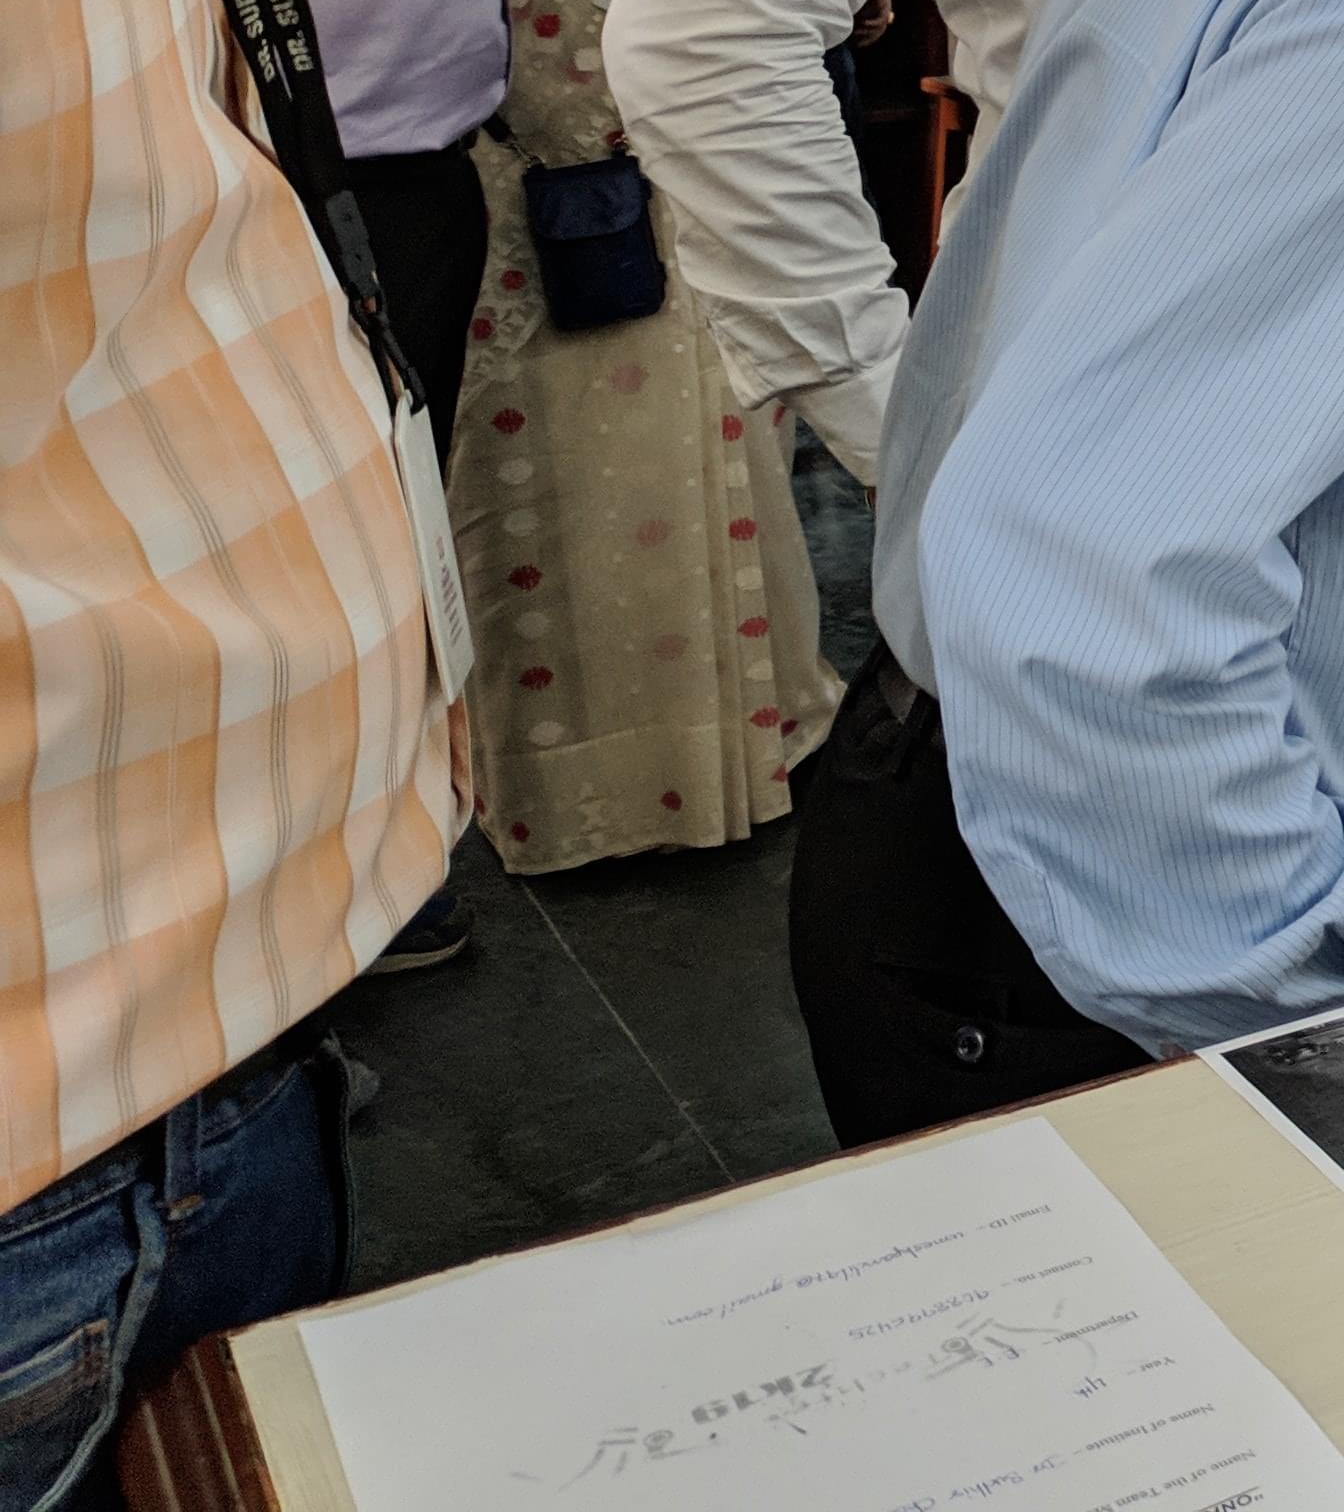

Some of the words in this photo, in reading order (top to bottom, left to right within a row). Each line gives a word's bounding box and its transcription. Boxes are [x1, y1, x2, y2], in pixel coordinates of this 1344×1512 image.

[257, 38, 275, 83] DR.
[286, 30, 313, 72] DR.
[1137, 1353, 1176, 1375] Year
[1148, 1416, 1168, 1434] of
[1167, 1401, 1215, 1427] Name
[1083, 1423, 1149, 1456] Institute
[1207, 1447, 1256, 1473] Name
[1161, 1474, 1190, 1493] the
[1188, 1467, 1208, 1484] of
[1112, 1484, 1160, 1512] Team
